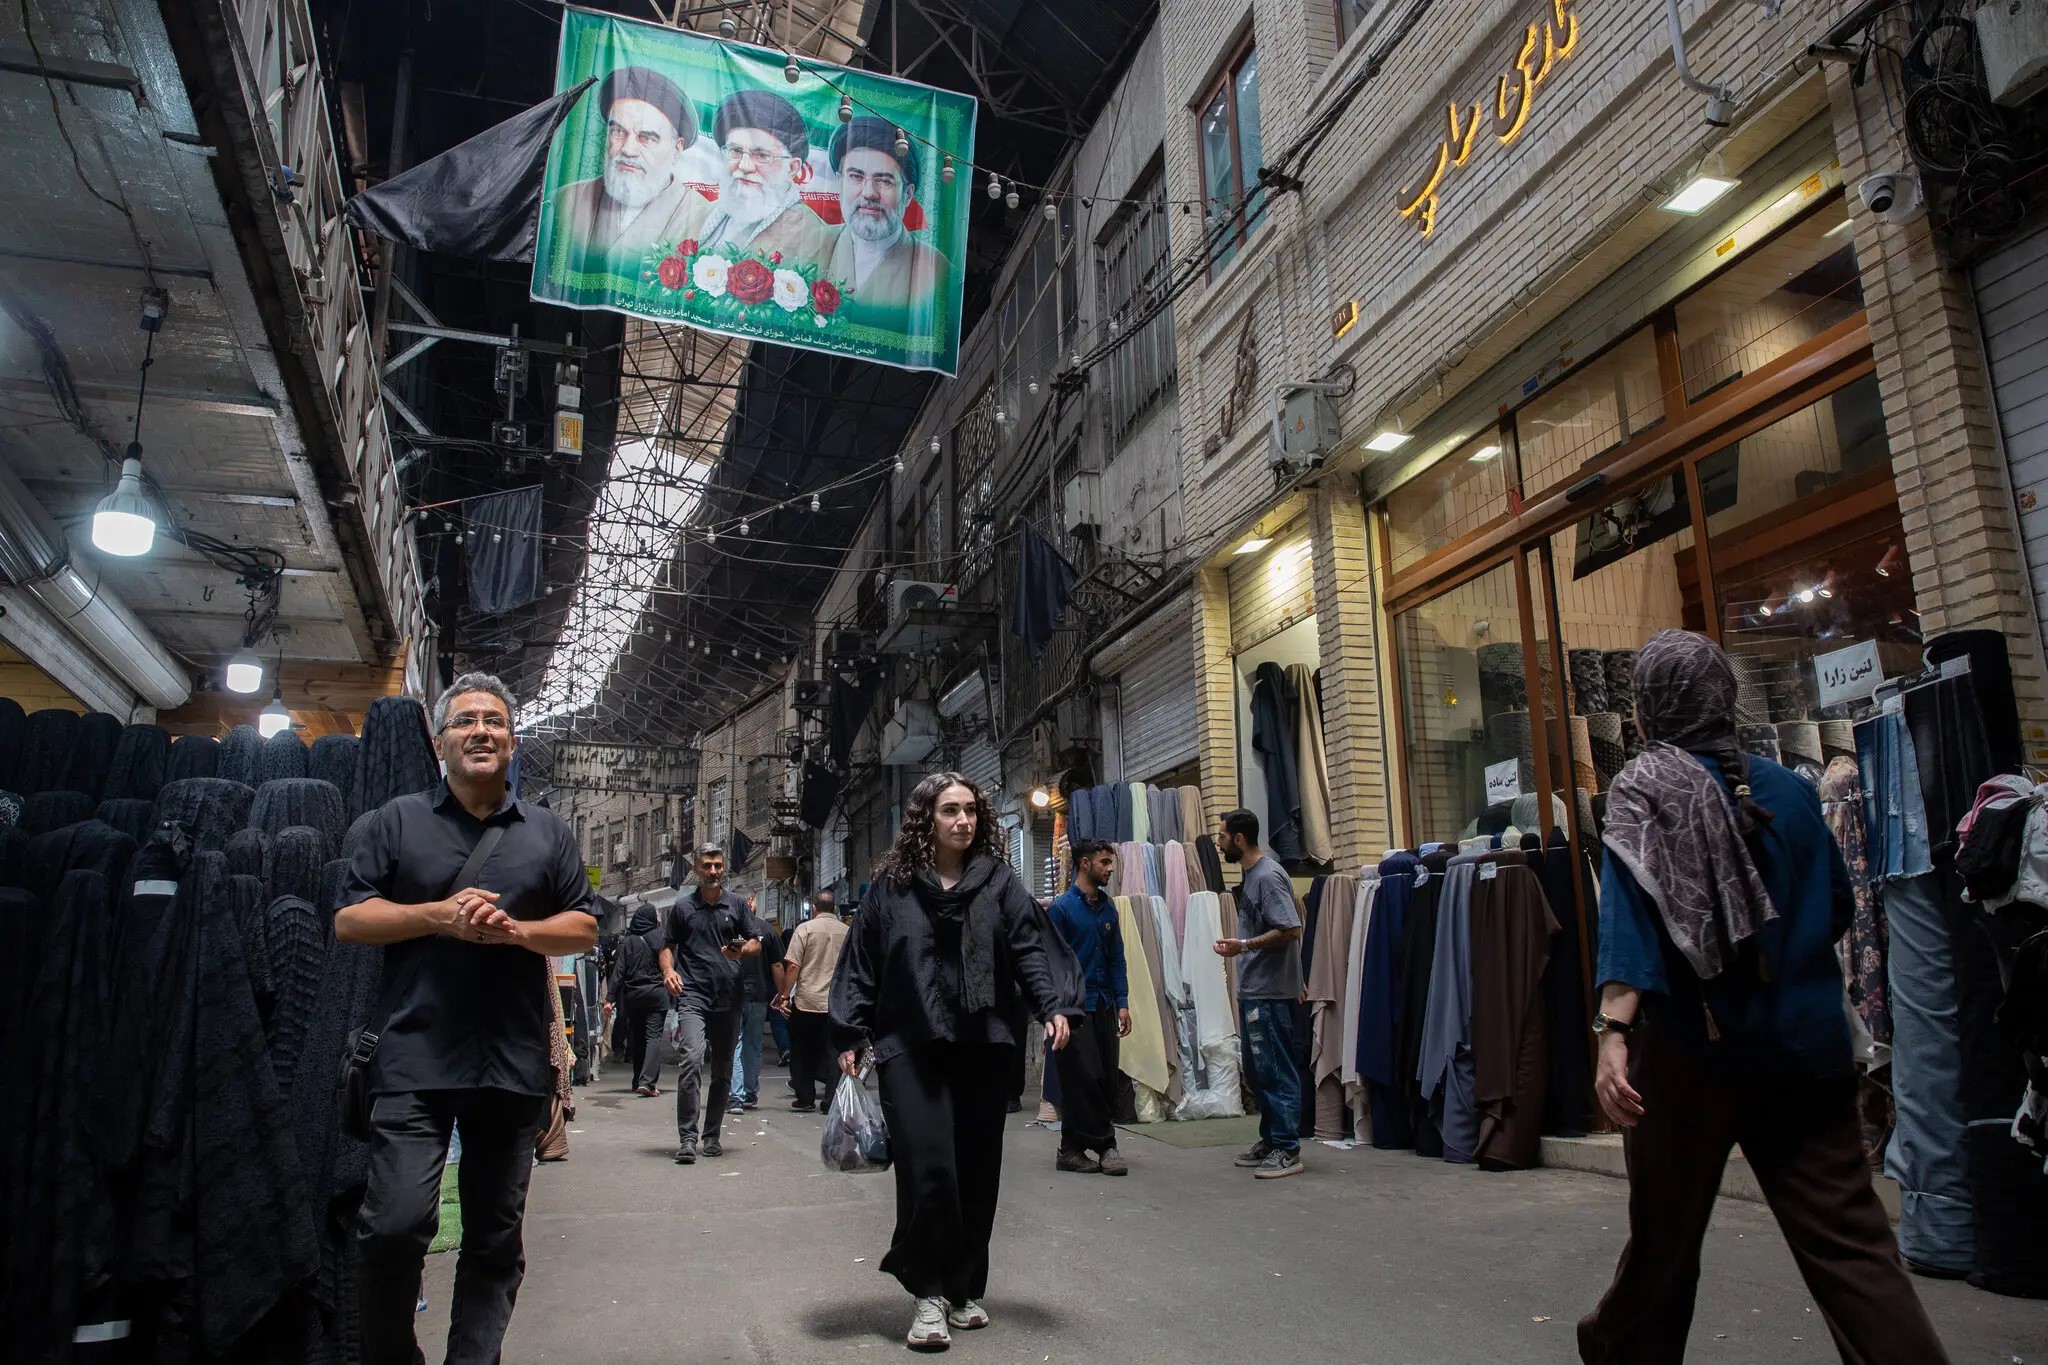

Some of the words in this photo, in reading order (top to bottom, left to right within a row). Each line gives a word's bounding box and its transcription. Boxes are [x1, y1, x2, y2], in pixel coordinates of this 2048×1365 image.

[615, 298, 633, 308] تهران
[633, 302, 648, 312] بازار
[690, 314, 711, 324] مسجد
[736, 323, 763, 334] فرهنگی
[763, 329, 784, 338] شورای
[790, 334, 812, 342] قماش
[813, 338, 831, 346] صنف
[831, 342, 855, 351] اسلامی
[855, 347, 877, 356] انجمن
[1850, 657, 1873, 681] لنین
[1823, 667, 1847, 688] زارا
[1489, 776, 1503, 788] ساده
